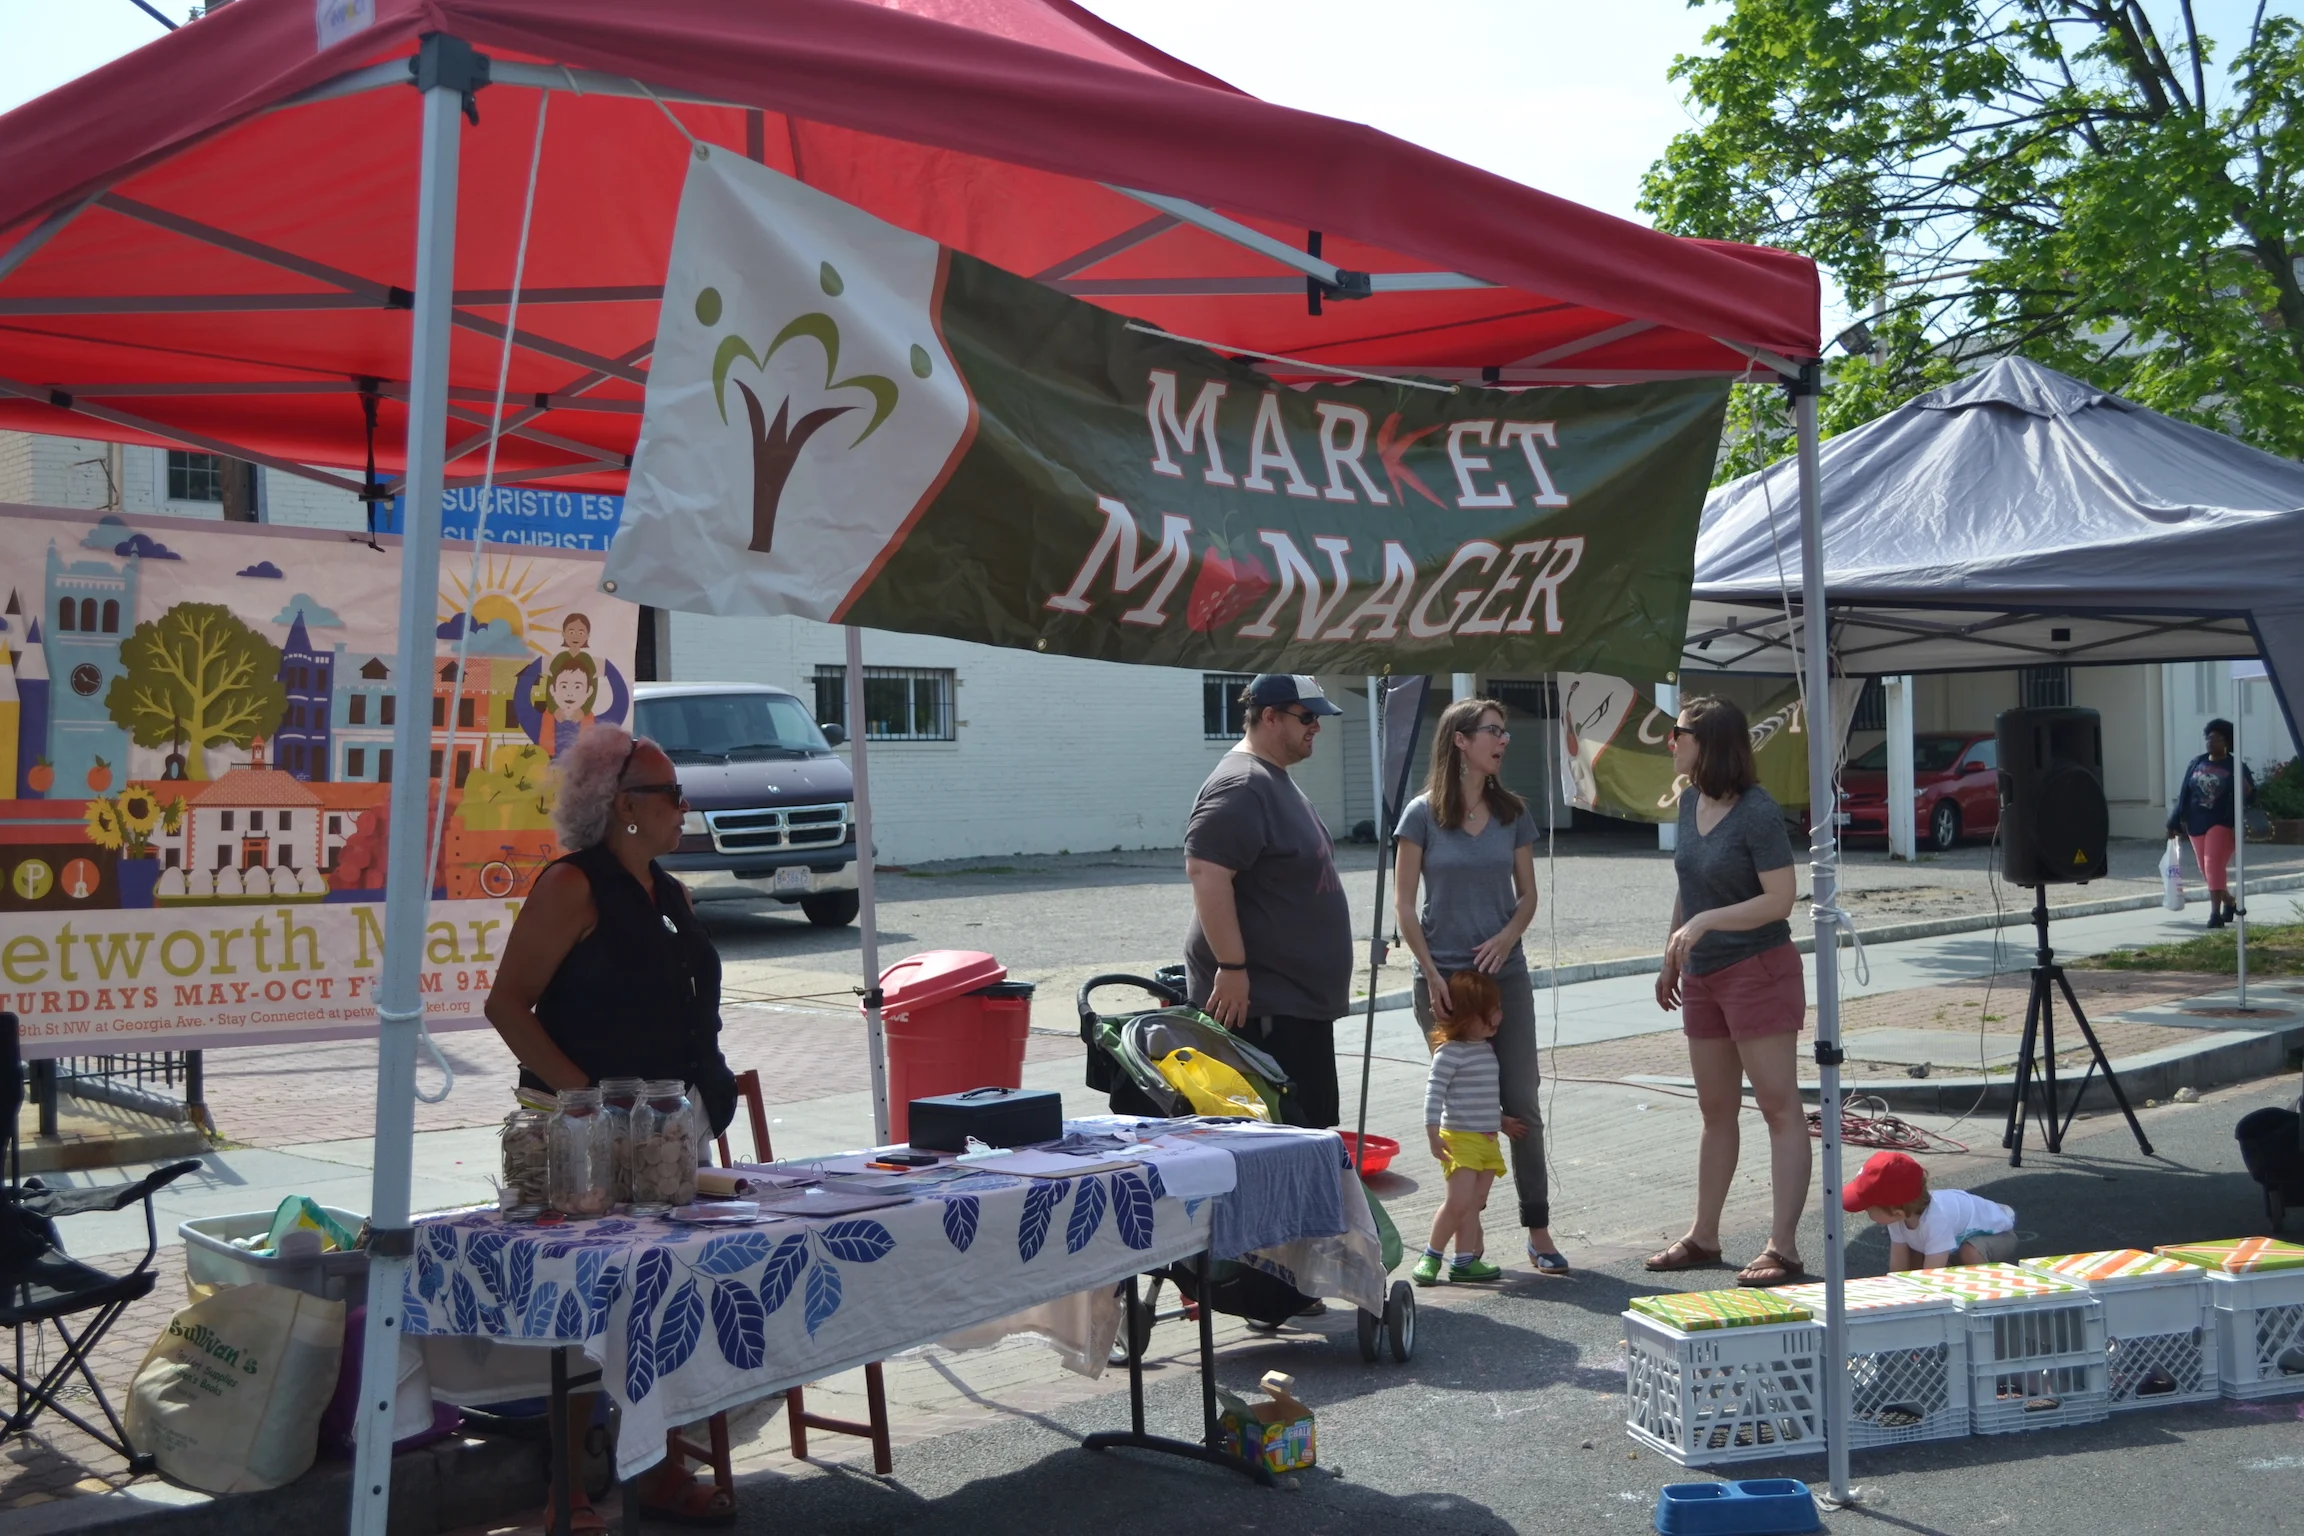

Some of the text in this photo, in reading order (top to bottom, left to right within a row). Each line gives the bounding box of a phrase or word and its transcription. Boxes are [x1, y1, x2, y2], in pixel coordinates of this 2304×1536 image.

[1146, 368, 1569, 511] MARKET
[581, 494, 614, 520] ES
[1043, 495, 1586, 641] MNAGER
[2, 902, 520, 984] etworth Mar
[0, 969, 498, 1014] TURDAYS MAY-OCT FM 9A
[45, 1023, 59, 1036] St
[63, 1021, 91, 1034] NW
[95, 1021, 109, 1033] at
[112, 1016, 172, 1032] Georgia
[176, 1015, 206, 1028] Ave.
[218, 1012, 247, 1027] Stay
[251, 1008, 325, 1024] Connected
[328, 1007, 341, 1019] at
[168, 1317, 258, 1374] Sullivan's
[199, 1378, 224, 1397] Books
[203, 1366, 239, 1388] Supplies
